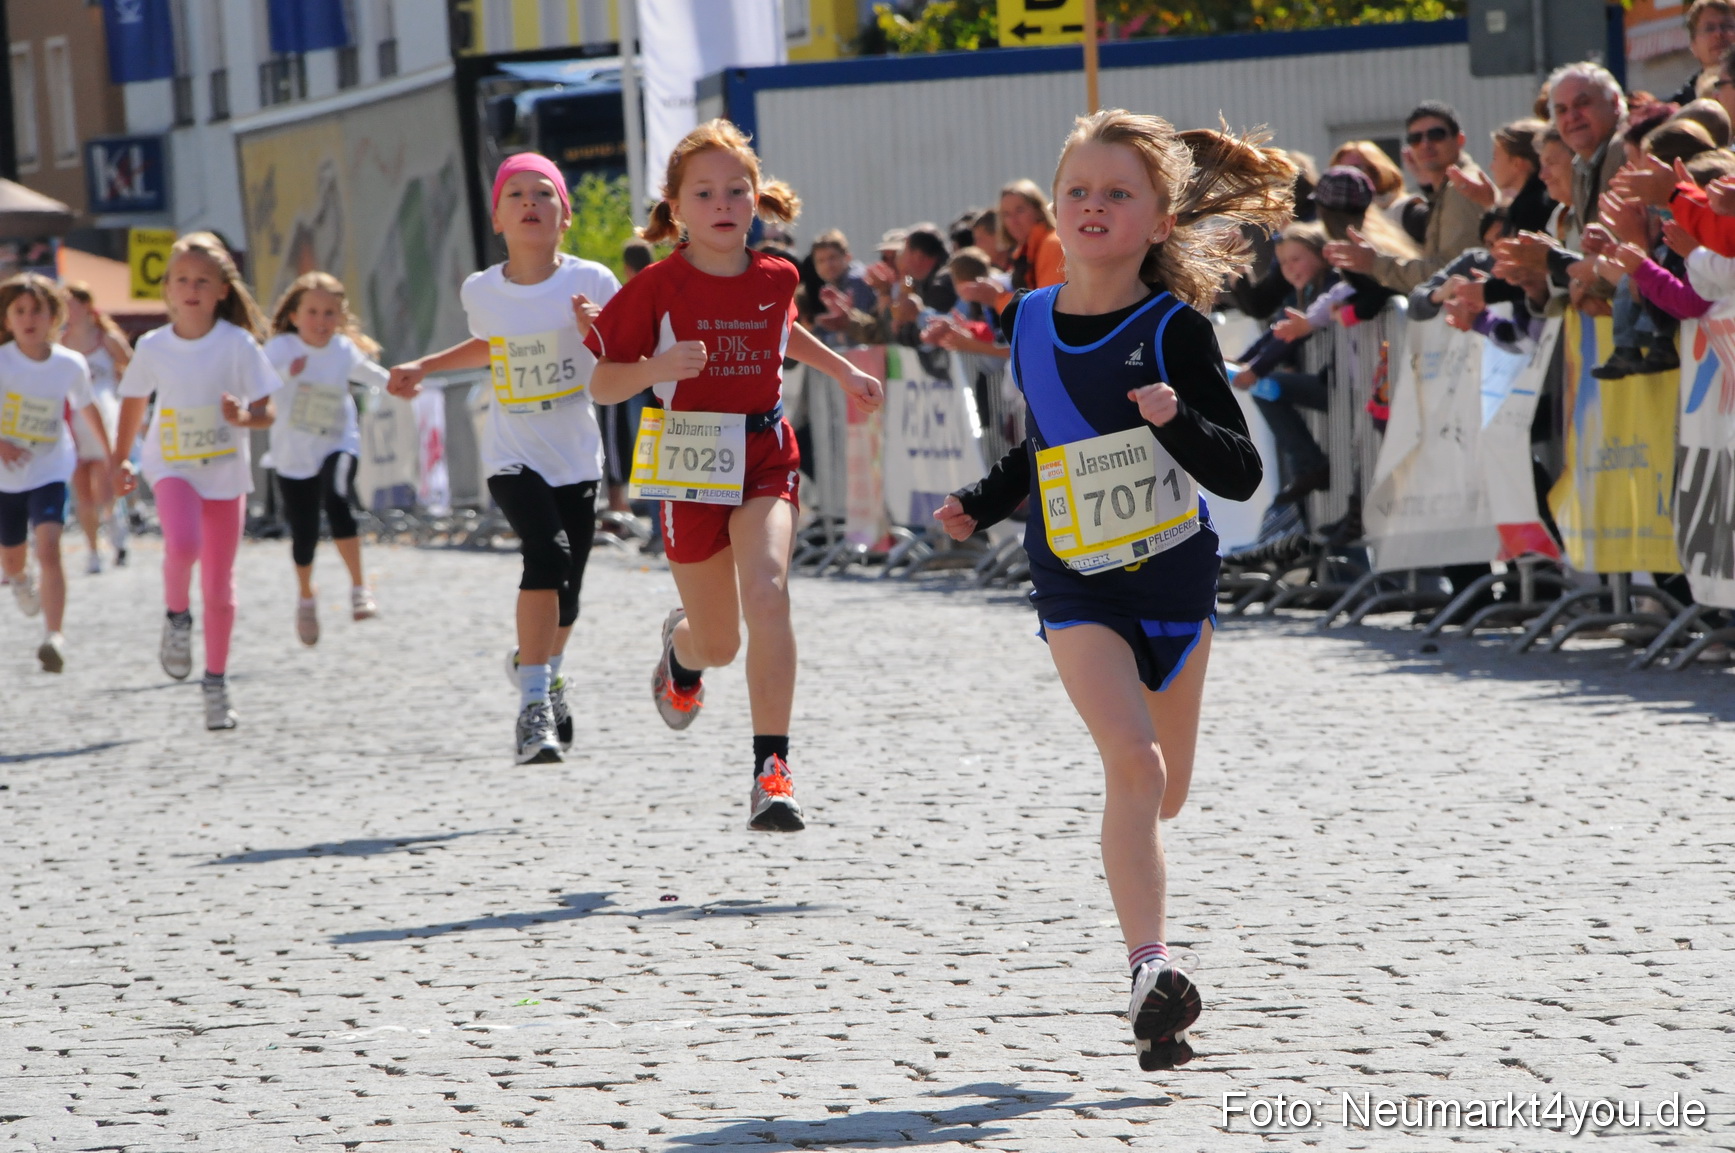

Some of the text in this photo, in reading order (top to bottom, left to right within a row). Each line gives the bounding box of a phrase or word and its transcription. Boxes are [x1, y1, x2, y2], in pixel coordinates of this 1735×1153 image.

[697, 319, 713, 330] 30.
[508, 339, 546, 358] Sarah
[717, 336, 751, 356] DJK
[514, 358, 576, 388] 7125
[709, 365, 762, 377] 17.04.2010
[181, 425, 231, 448] 7206
[638, 442, 653, 456] K3
[664, 445, 735, 473] 7029
[1075, 443, 1148, 477] Jasmin
[698, 489, 741, 499] PFLEIDERER
[1083, 468, 1182, 527] 7071
[1048, 497, 1067, 518] K3
[1148, 516, 1198, 546] PFLEIDERER
[1071, 553, 1111, 570] BOCK
